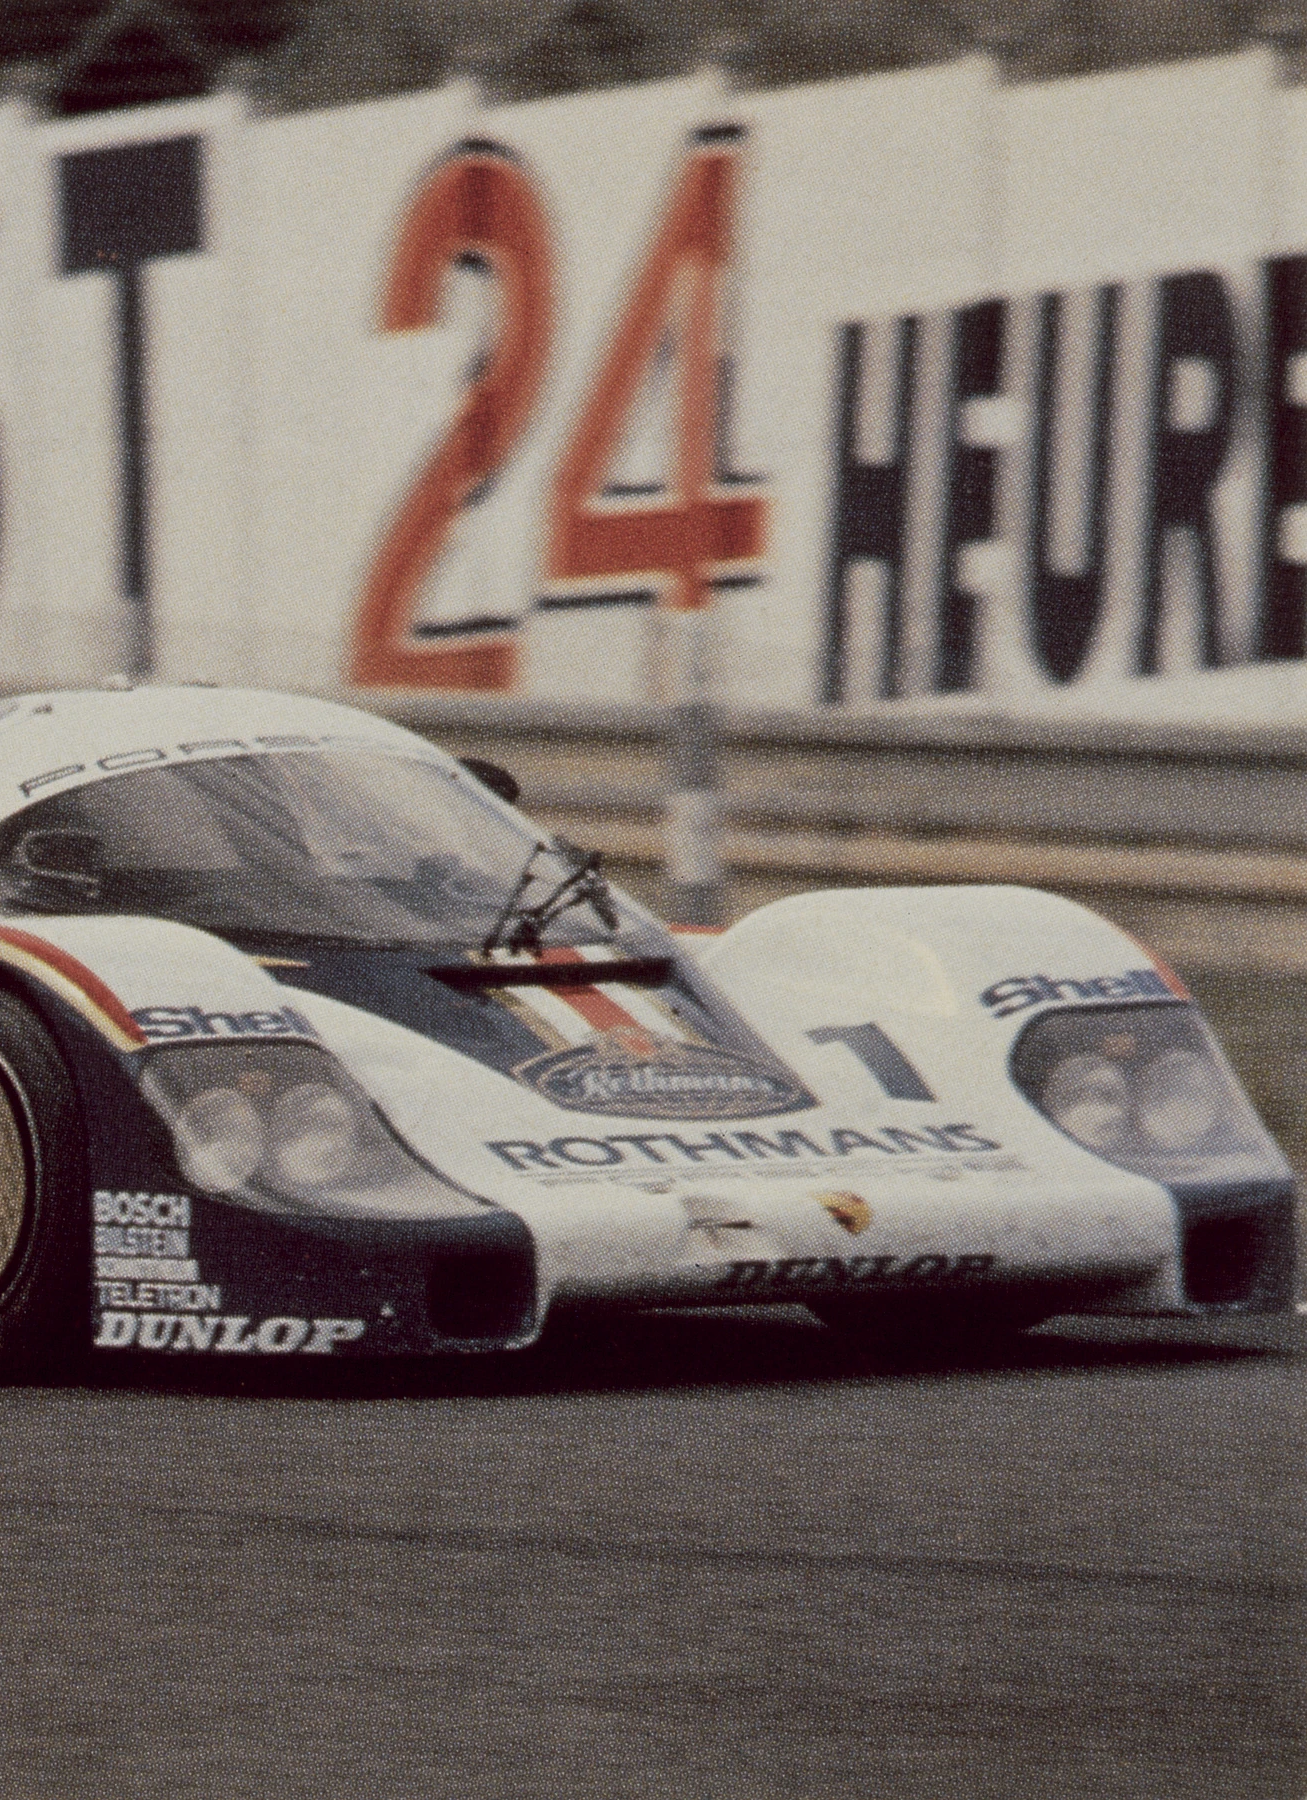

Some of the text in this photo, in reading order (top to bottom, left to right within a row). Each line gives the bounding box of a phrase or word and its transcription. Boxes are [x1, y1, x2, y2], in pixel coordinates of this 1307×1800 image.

[350, 124, 770, 690] 24
[805, 1021, 938, 1102] 1
[484, 1122, 1002, 1170] ROTHMANS
[93, 1189, 191, 1228] BOSCH
[93, 1311, 365, 1354] DUNLOP
